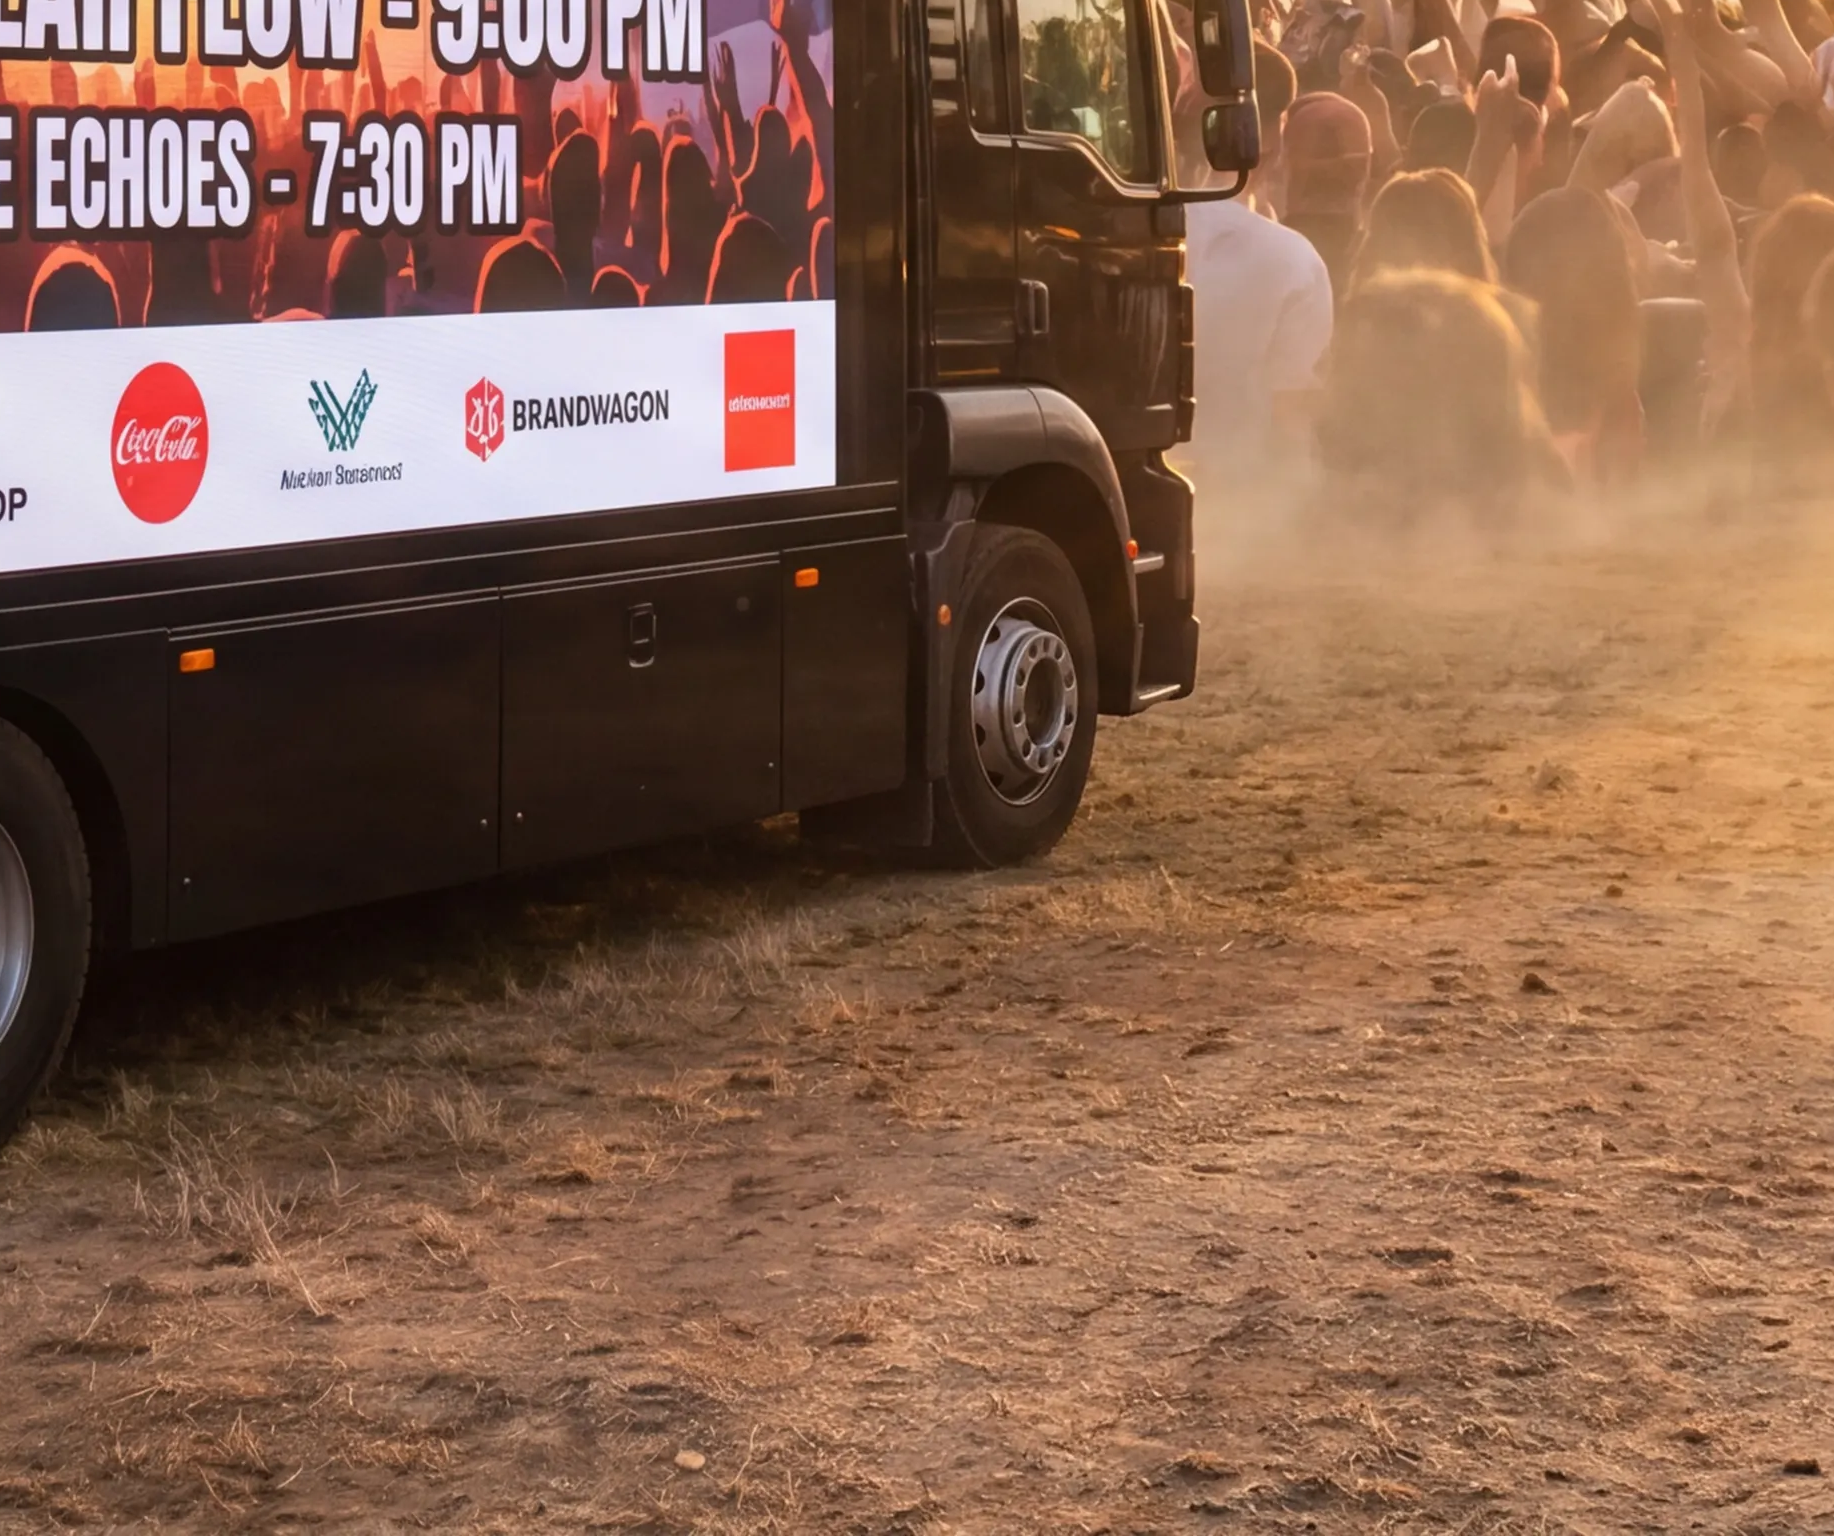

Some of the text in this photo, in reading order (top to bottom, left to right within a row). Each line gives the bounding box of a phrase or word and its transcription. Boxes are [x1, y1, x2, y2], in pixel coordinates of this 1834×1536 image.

[35, 116, 252, 231] ECHOES
[308, 119, 425, 229] 7:30
[440, 122, 519, 226] PM
[512, 388, 670, 433] BRANDWAGON
